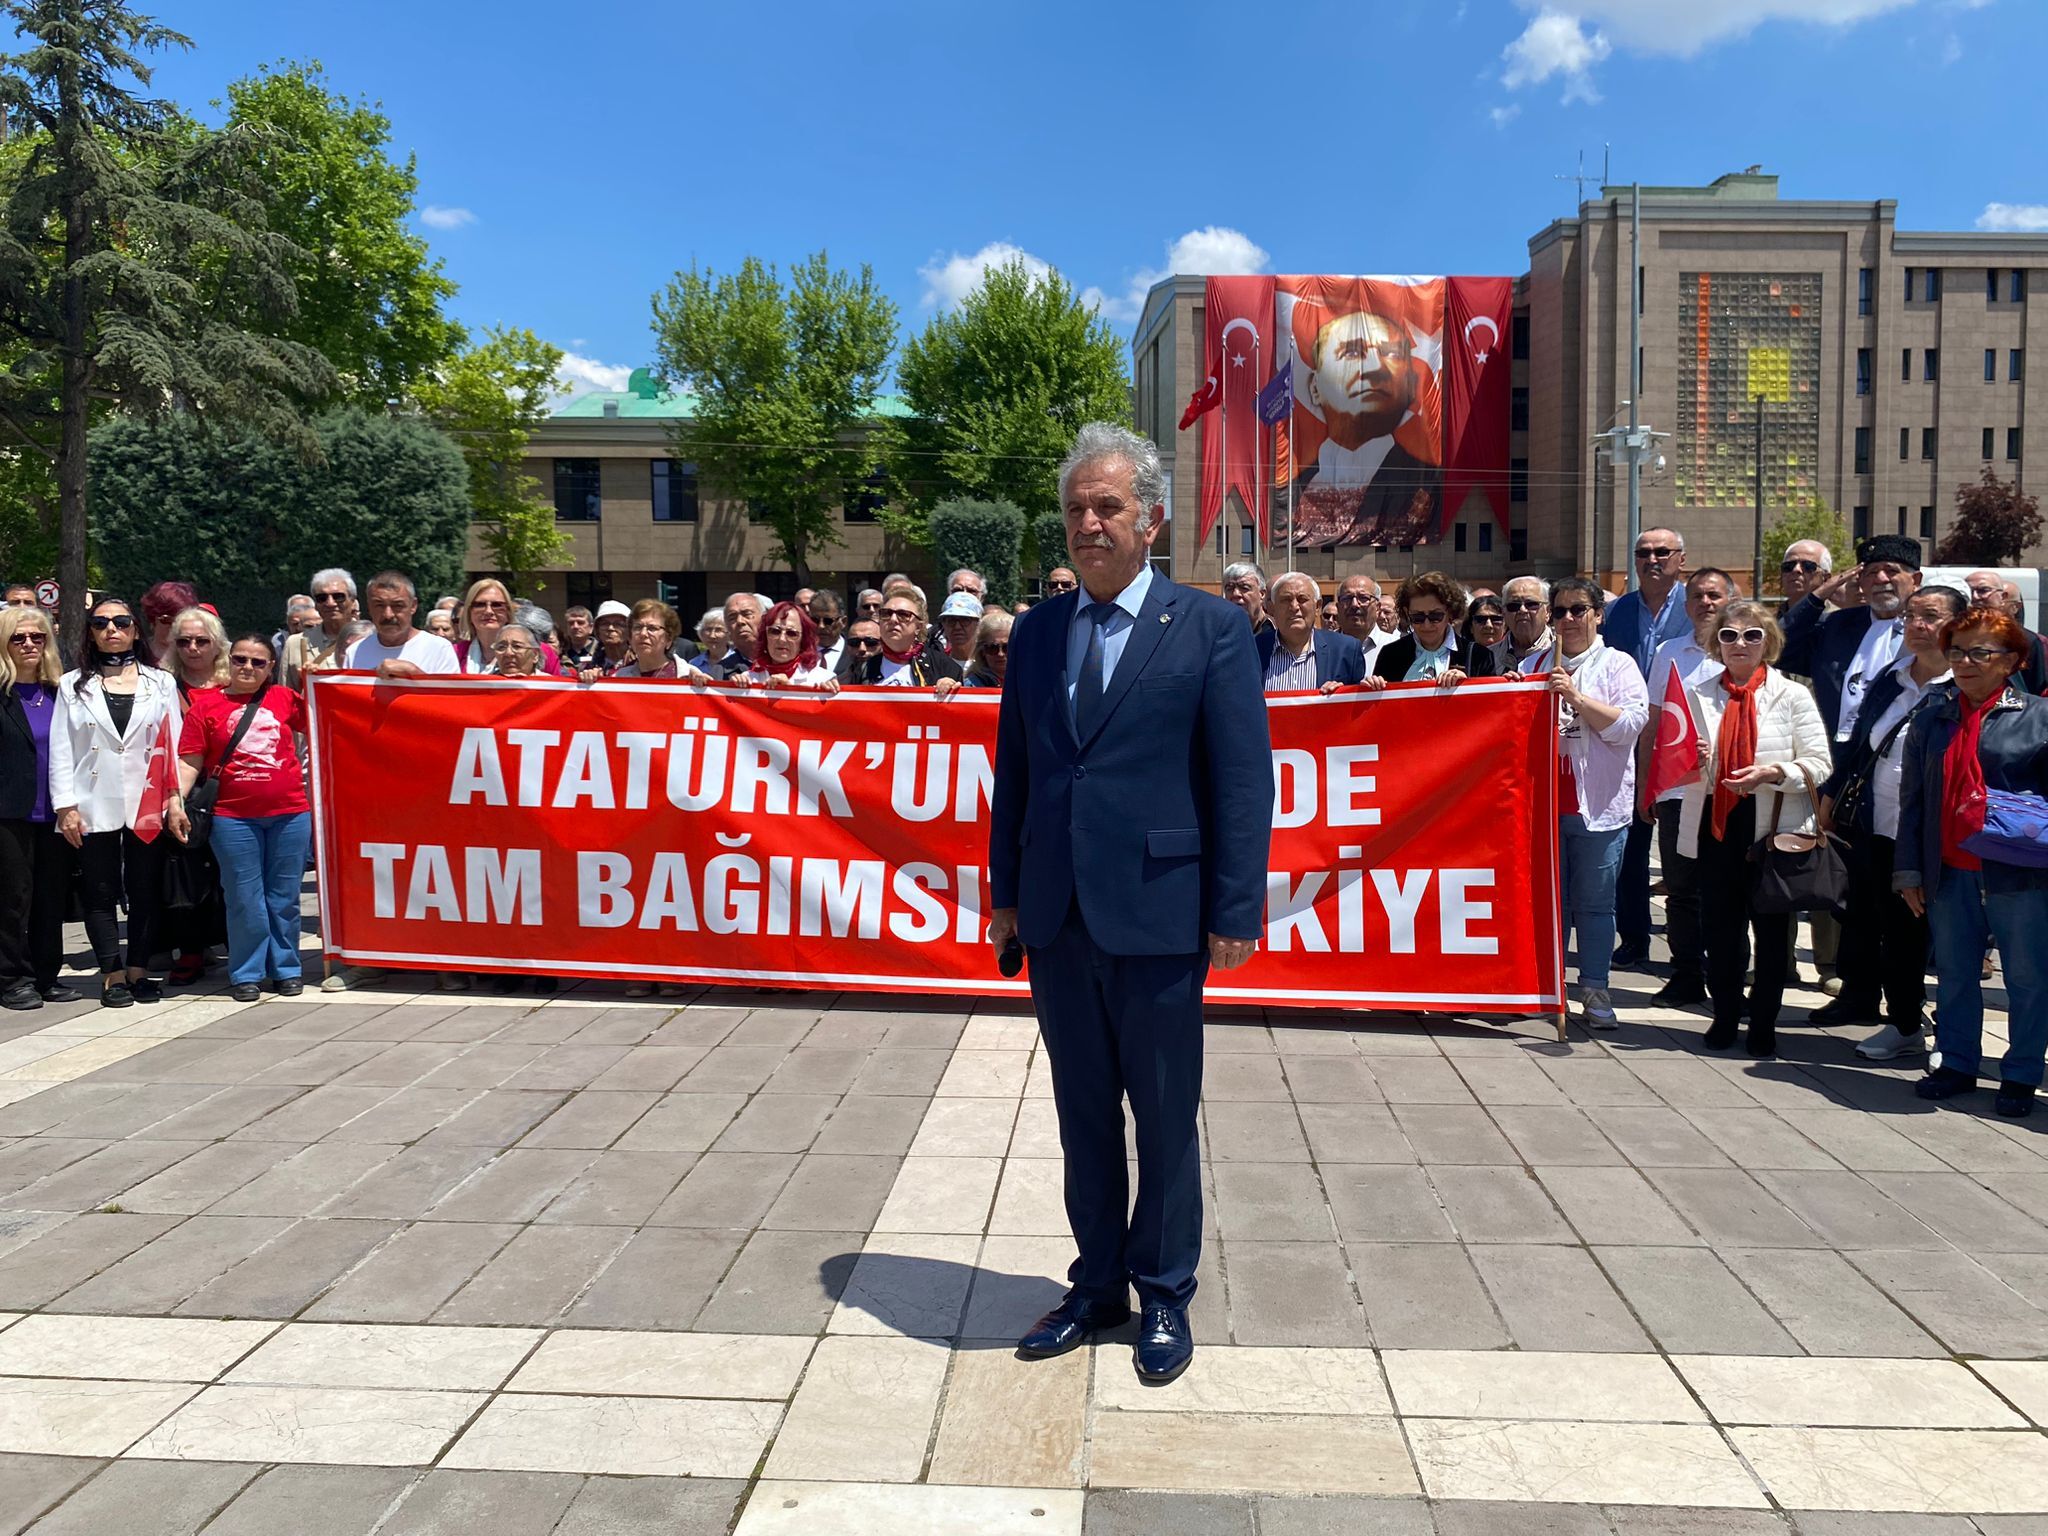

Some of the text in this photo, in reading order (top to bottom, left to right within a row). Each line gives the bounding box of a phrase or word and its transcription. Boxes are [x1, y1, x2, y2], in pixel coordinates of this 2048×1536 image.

[360, 832, 1499, 955] TAM BAĞIMSI KİYE
